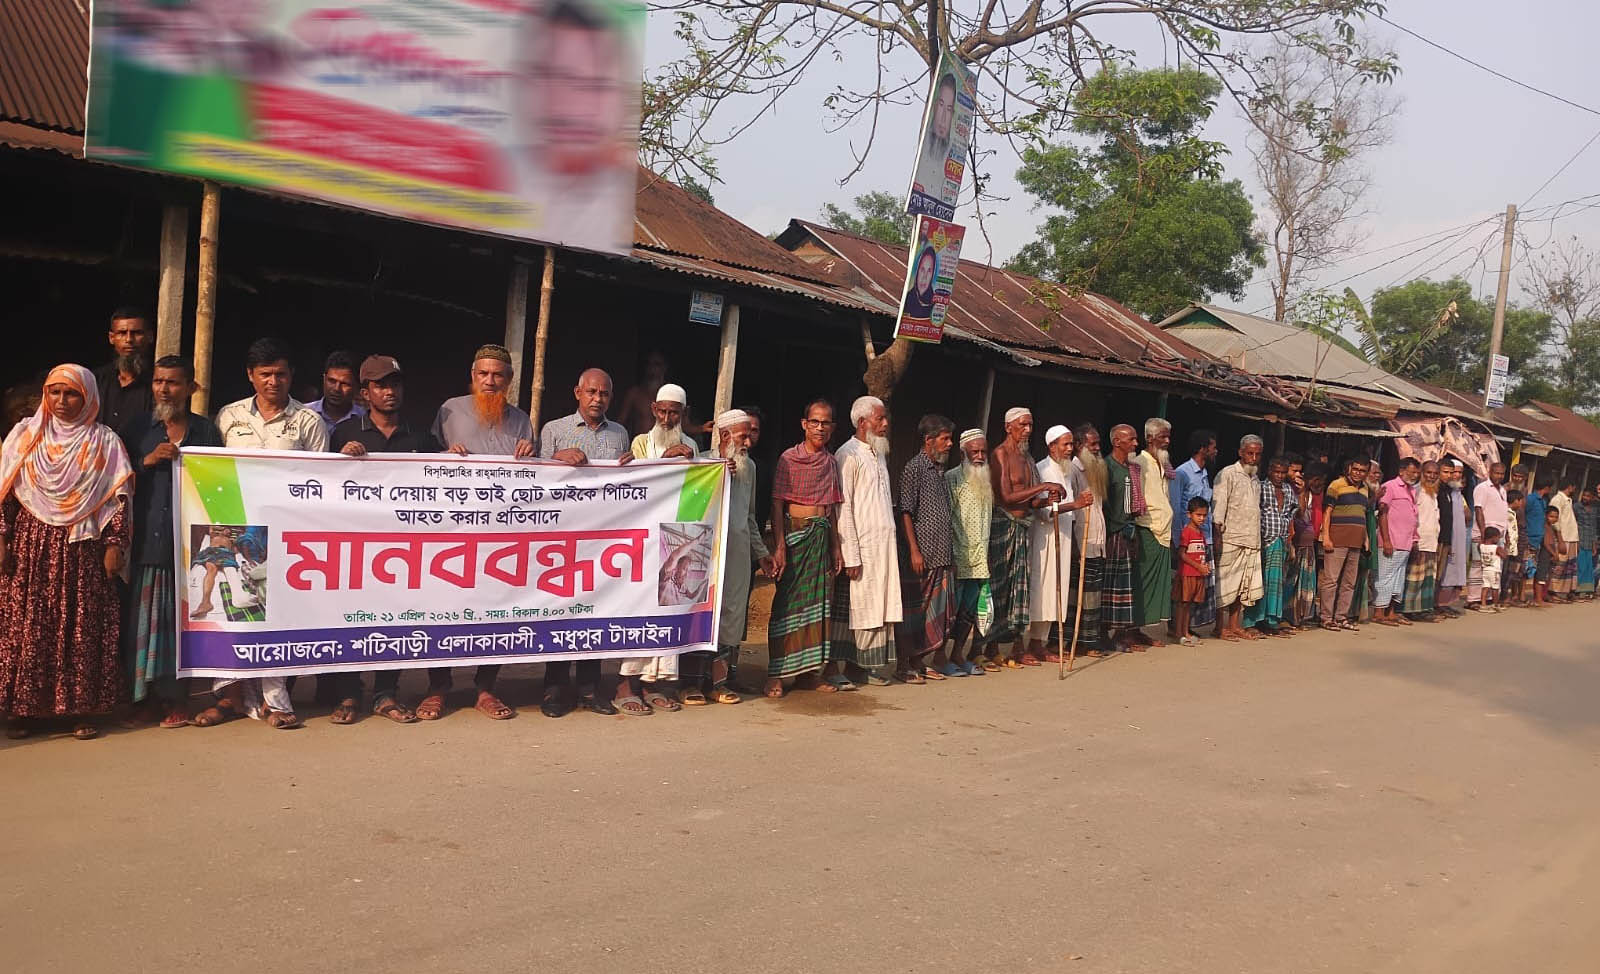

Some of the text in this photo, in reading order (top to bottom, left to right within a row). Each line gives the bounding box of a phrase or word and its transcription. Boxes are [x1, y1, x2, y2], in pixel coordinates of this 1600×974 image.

[514, 468, 537, 480] রাহিম
[288, 479, 648, 505] জমি লিখে দেয়ায় বড় ভাই ছোট ভাইকে পিটিয়ে
[395, 506, 562, 526] আহত করার প্রতিবাদে
[282, 529, 649, 597] মানববন্ধন
[381, 611, 394, 623] ২১
[398, 609, 425, 621] এপ্রিল
[429, 611, 459, 621] ২০২৬
[512, 606, 540, 618] বিকাল
[543, 607, 565, 617] ৪.০০
[568, 603, 594, 615] ঘটিকা
[350, 630, 432, 657] শটিবাড়ী
[550, 628, 604, 651] মধুপুর
